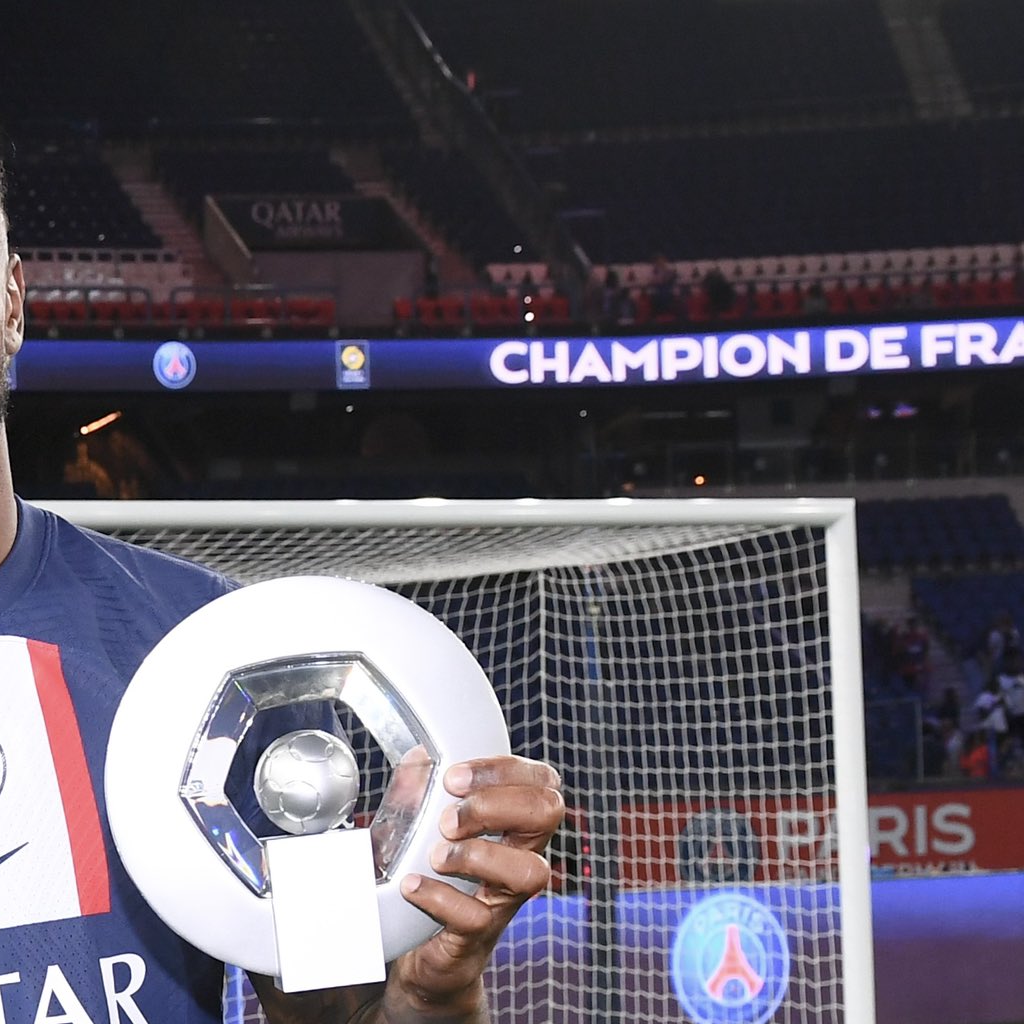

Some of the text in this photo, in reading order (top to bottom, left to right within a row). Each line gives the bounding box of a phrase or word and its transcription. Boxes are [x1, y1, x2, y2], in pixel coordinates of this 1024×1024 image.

[251, 200, 343, 230] QATAR
[490, 331, 810, 384] CHAMPION
[825, 327, 910, 373] DE
